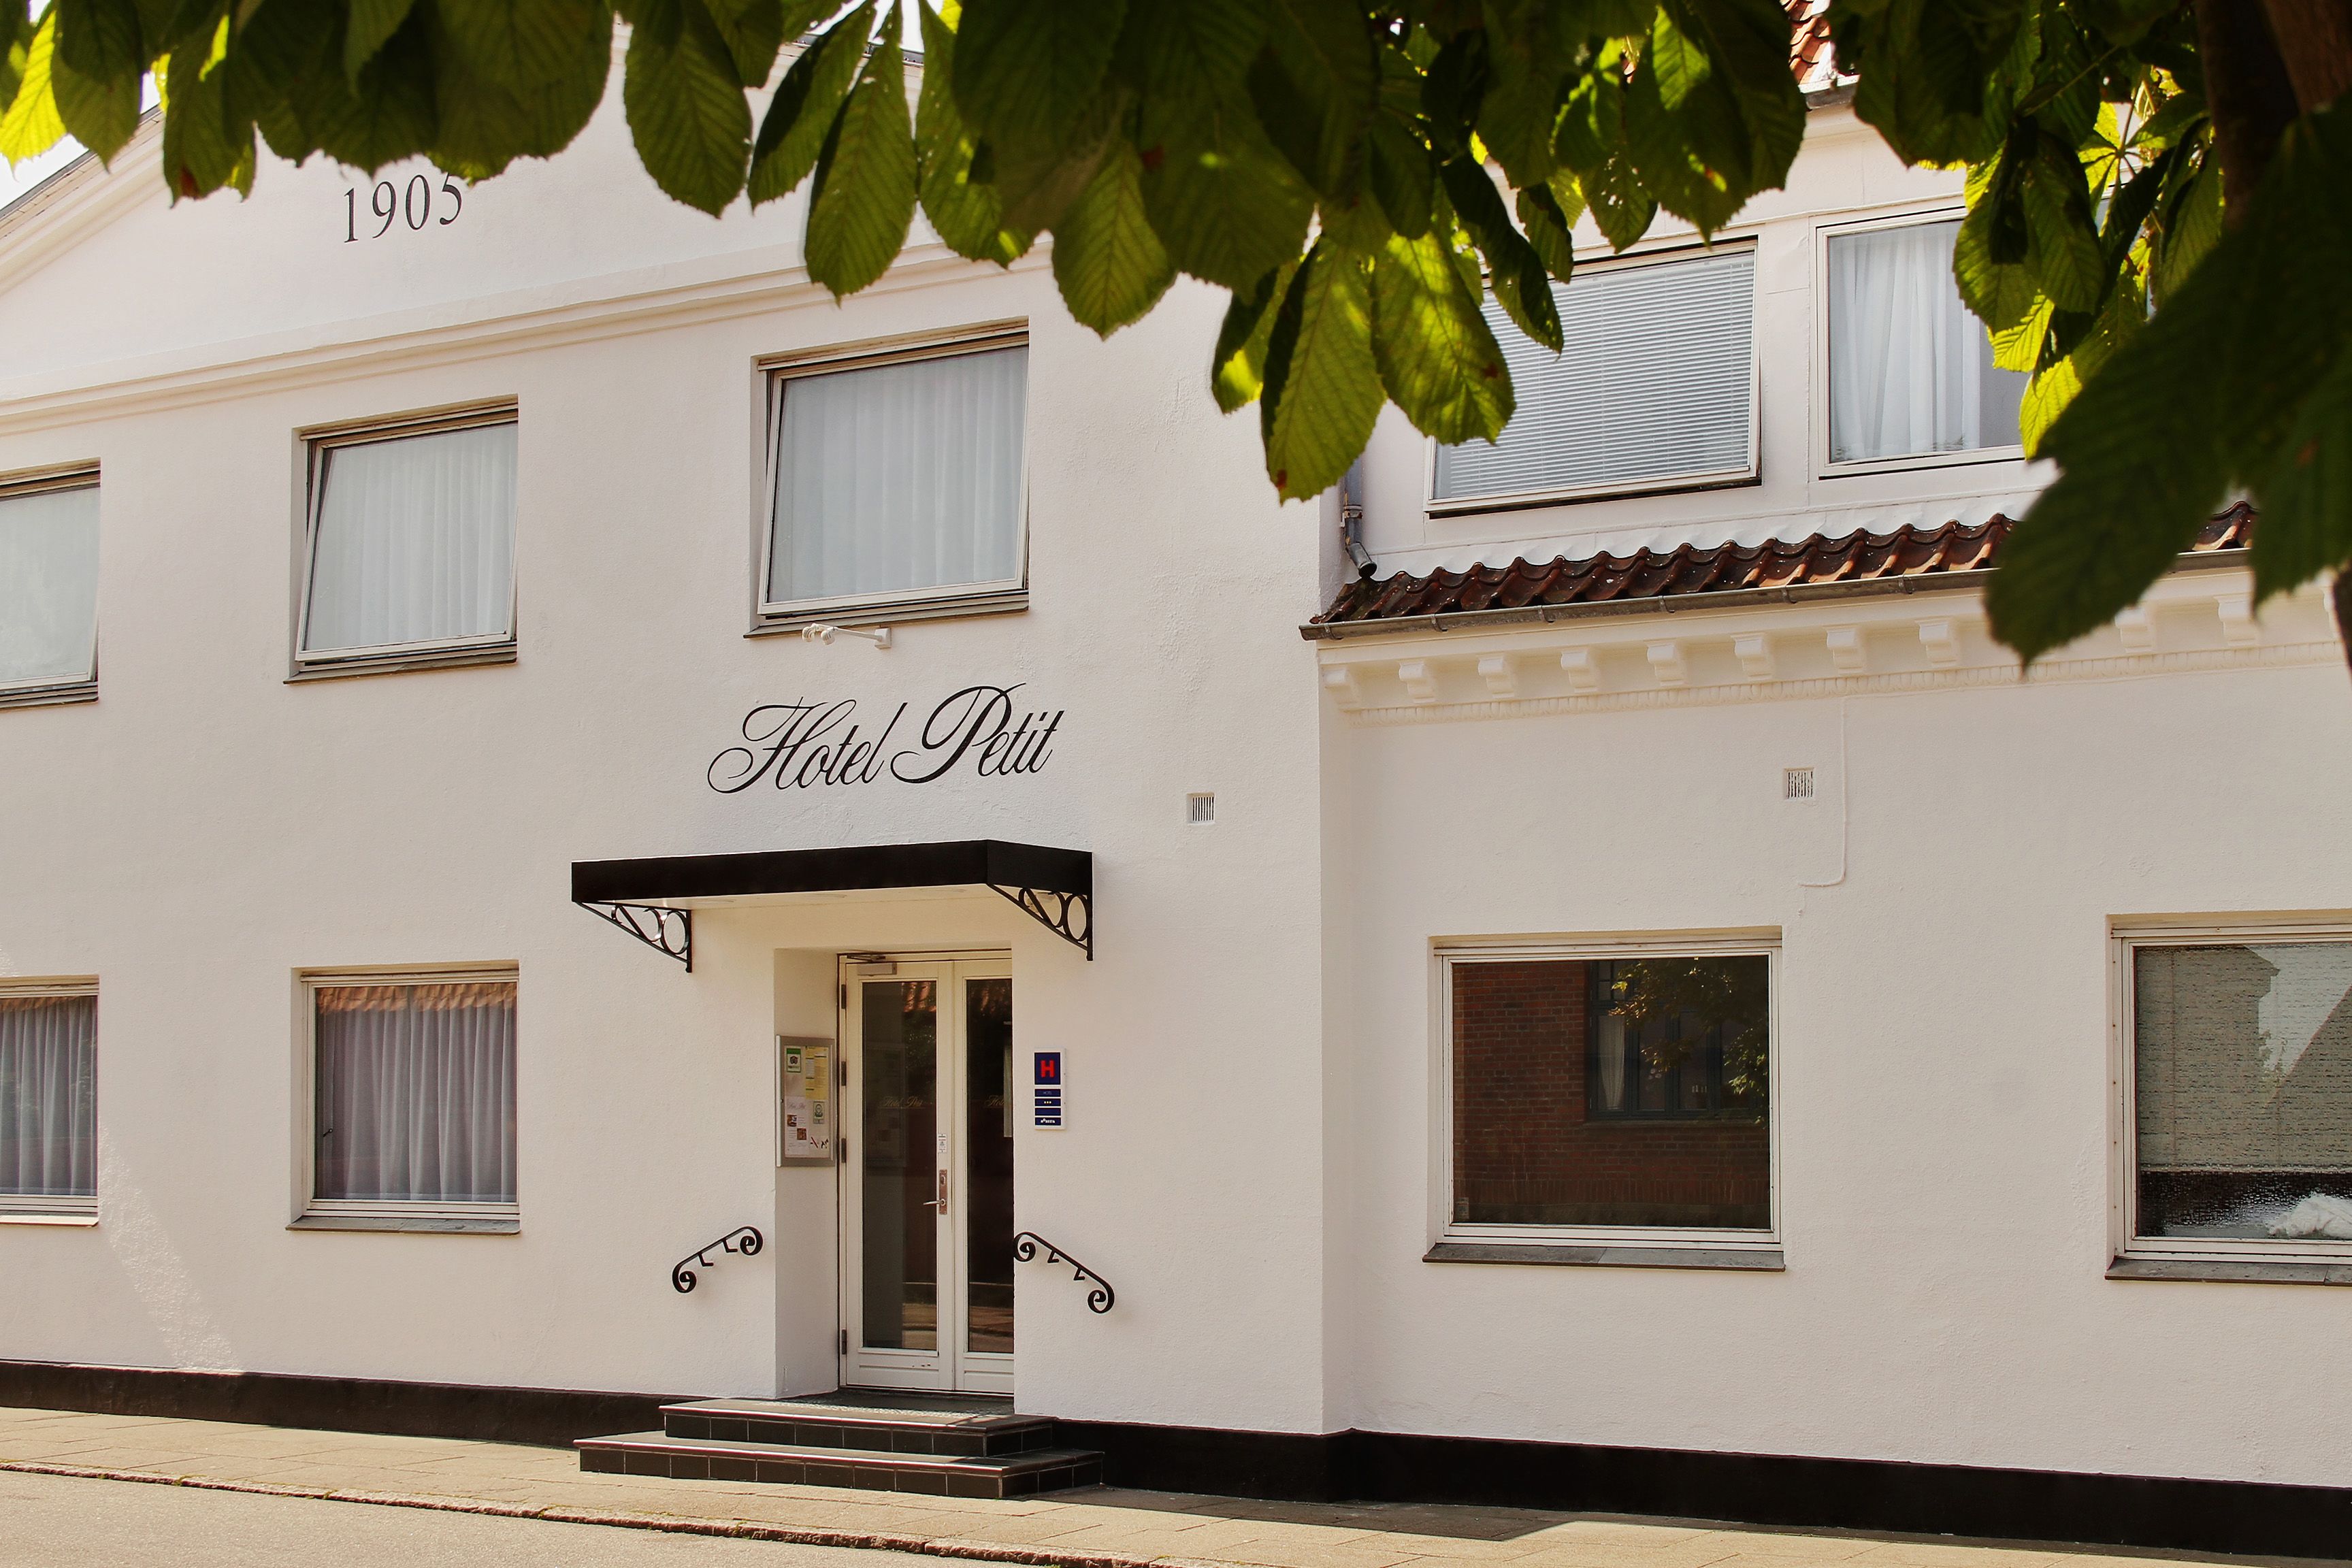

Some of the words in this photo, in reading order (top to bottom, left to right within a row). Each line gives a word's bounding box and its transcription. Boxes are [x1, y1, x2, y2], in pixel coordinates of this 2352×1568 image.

[344, 172, 462, 243] 1905
[707, 696, 908, 794] Hotel
[890, 683, 1065, 784] Petit
[1041, 1060, 1055, 1077] H
